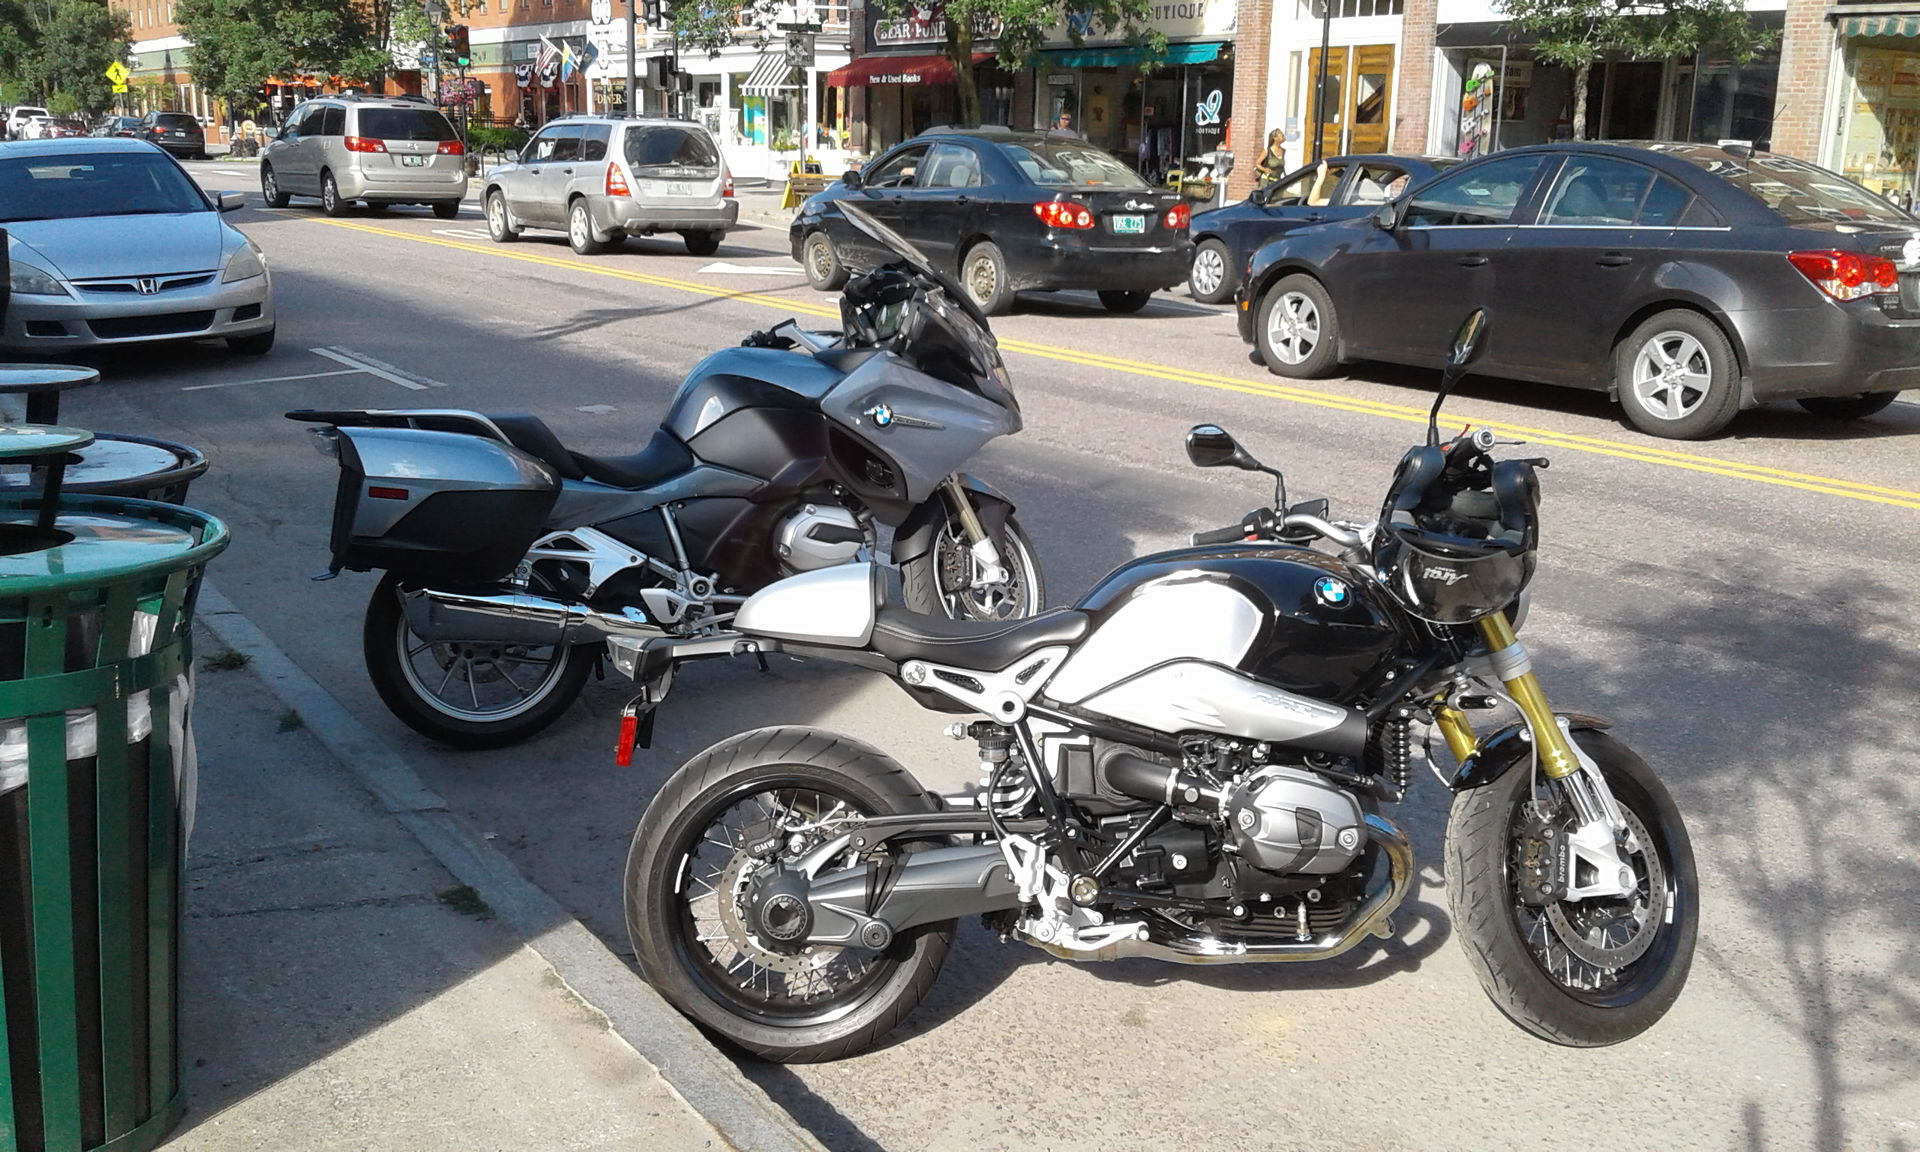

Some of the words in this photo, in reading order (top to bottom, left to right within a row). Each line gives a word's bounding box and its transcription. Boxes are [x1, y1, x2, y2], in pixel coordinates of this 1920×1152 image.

[880, 22, 911, 40] BEAR
[869, 75, 881, 84] New
[881, 74, 888, 84] &
[888, 74, 902, 84] Used
[902, 73, 921, 83] Books
[597, 93, 623, 105] DINER
[1422, 567, 1469, 586] Arai
[753, 838, 775, 853] BMW
[1557, 844, 1566, 883] brembo
